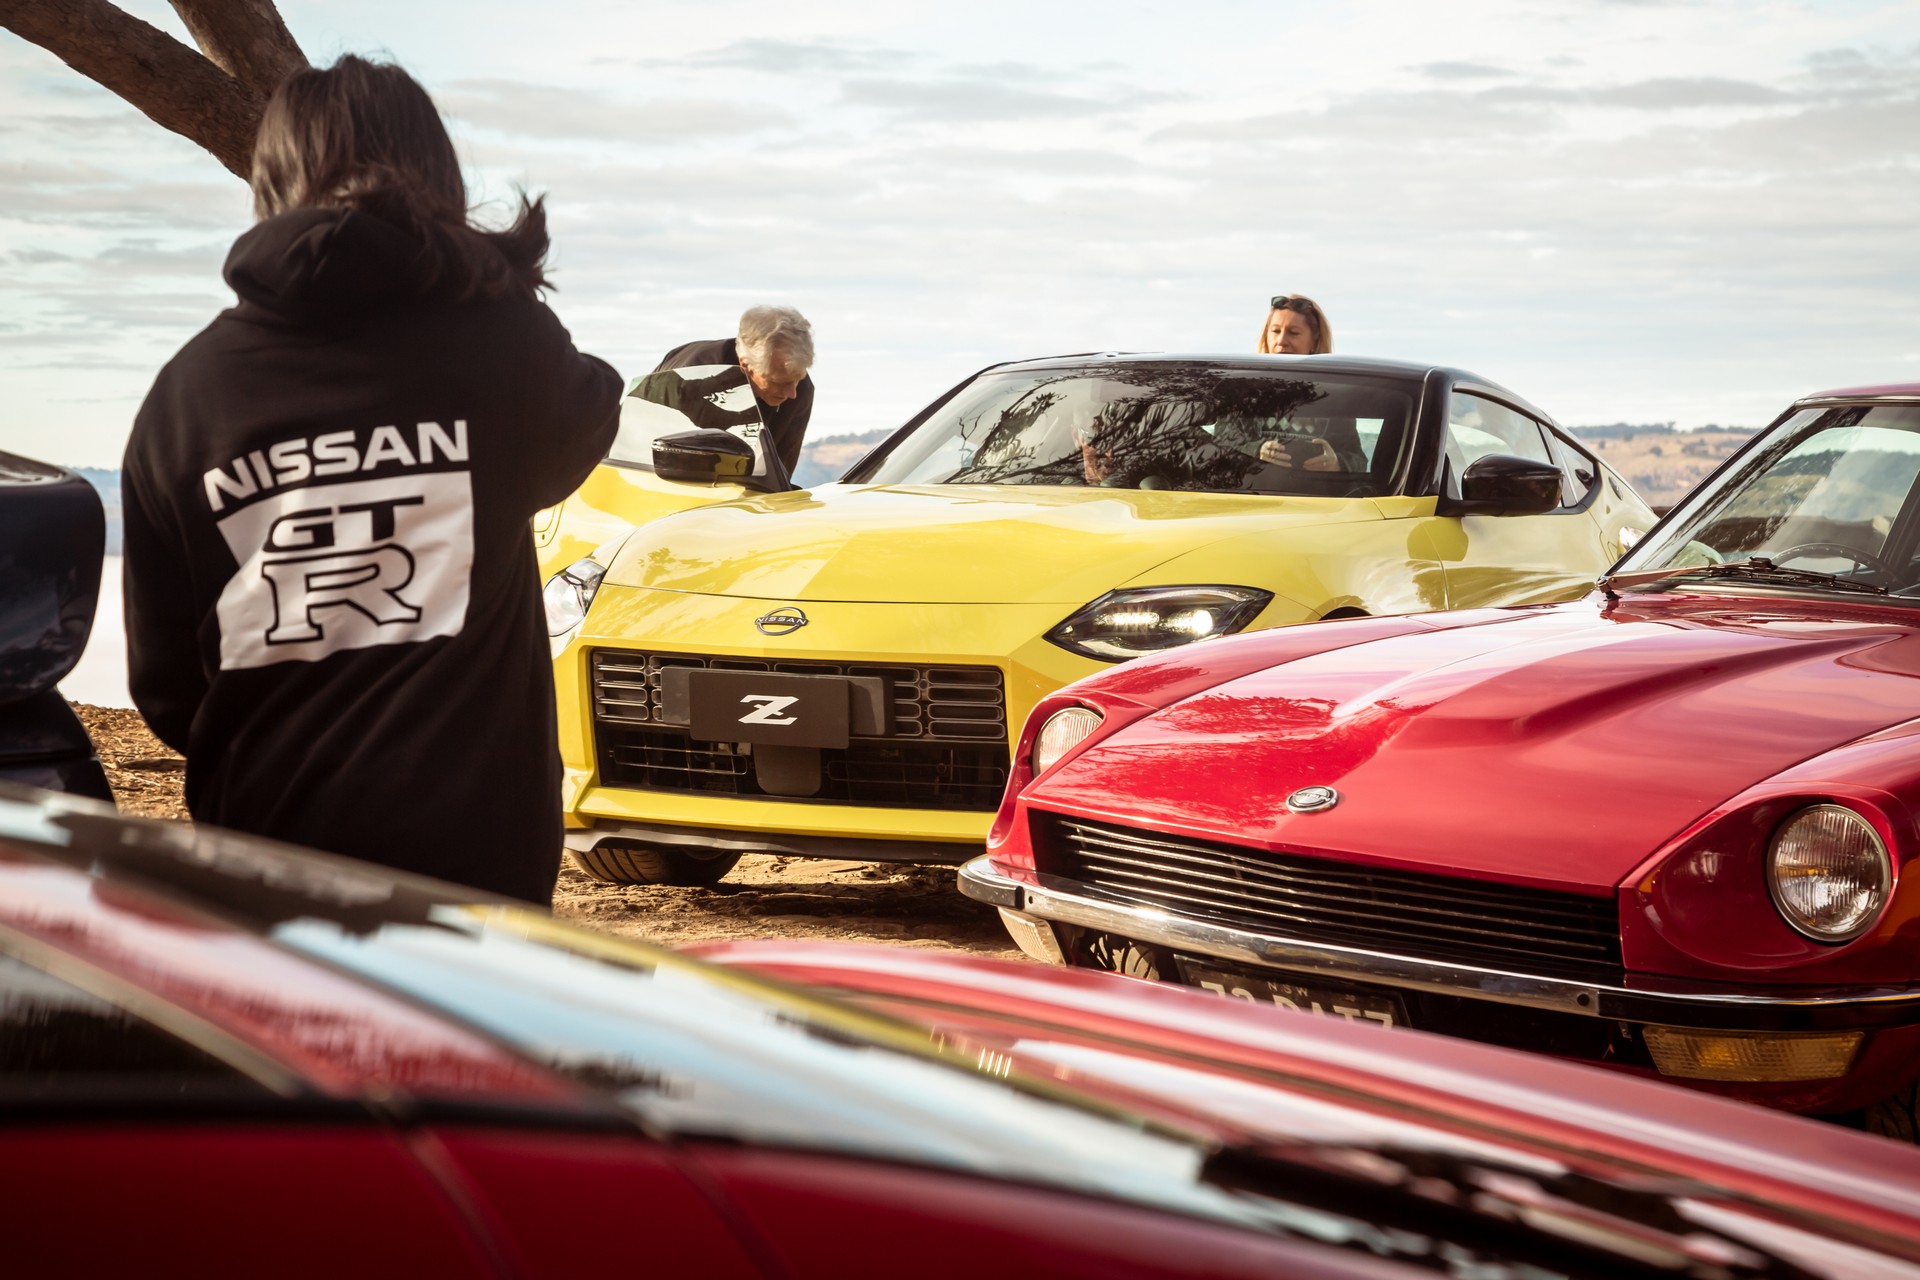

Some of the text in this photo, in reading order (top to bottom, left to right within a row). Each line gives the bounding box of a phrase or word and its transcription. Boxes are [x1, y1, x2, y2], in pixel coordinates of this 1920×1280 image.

[203, 419, 469, 512] NISSAN
[755, 616, 807, 625] NISSAN
[738, 694, 799, 725] Z
[1267, 981, 1308, 997] NSW
